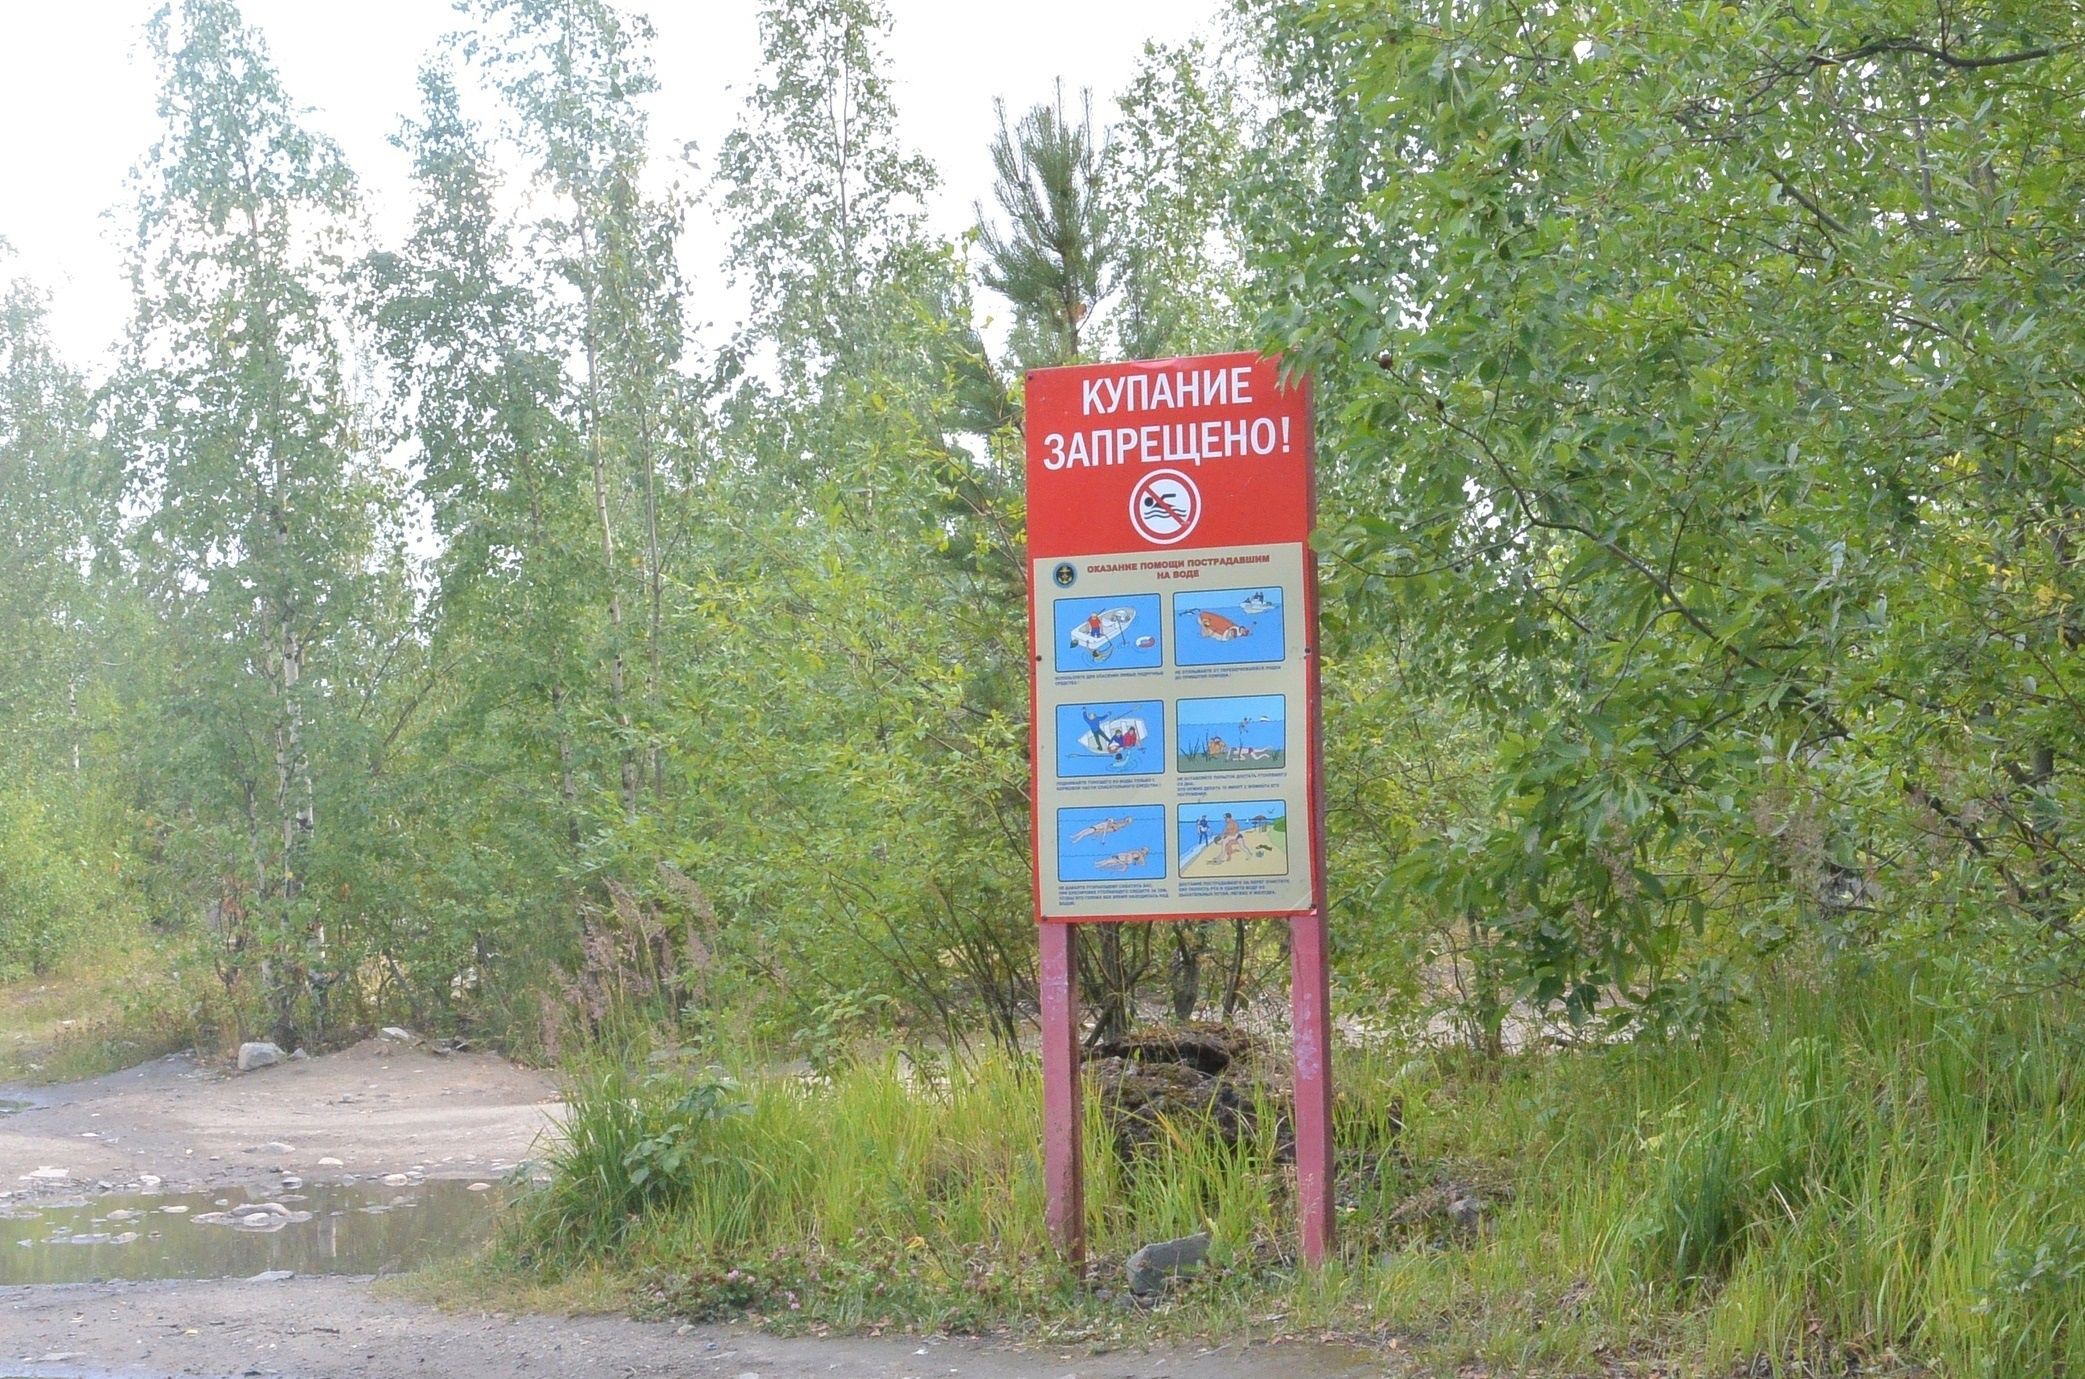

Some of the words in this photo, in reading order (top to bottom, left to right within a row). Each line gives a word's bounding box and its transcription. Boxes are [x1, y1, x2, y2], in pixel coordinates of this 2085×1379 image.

[1082, 366, 1253, 416] КУПАНИЕ
[1043, 416, 1290, 471] ЗАПРЕЩЕНО!
[1087, 562, 1138, 574] ОКАЗАНИЕ
[1140, 559, 1185, 570] ПОМОЩИ
[1187, 554, 1271, 568] ПОСТРАДАВШИМ
[1157, 571, 1170, 580] НА
[1173, 569, 1200, 580] ВОДЕ
